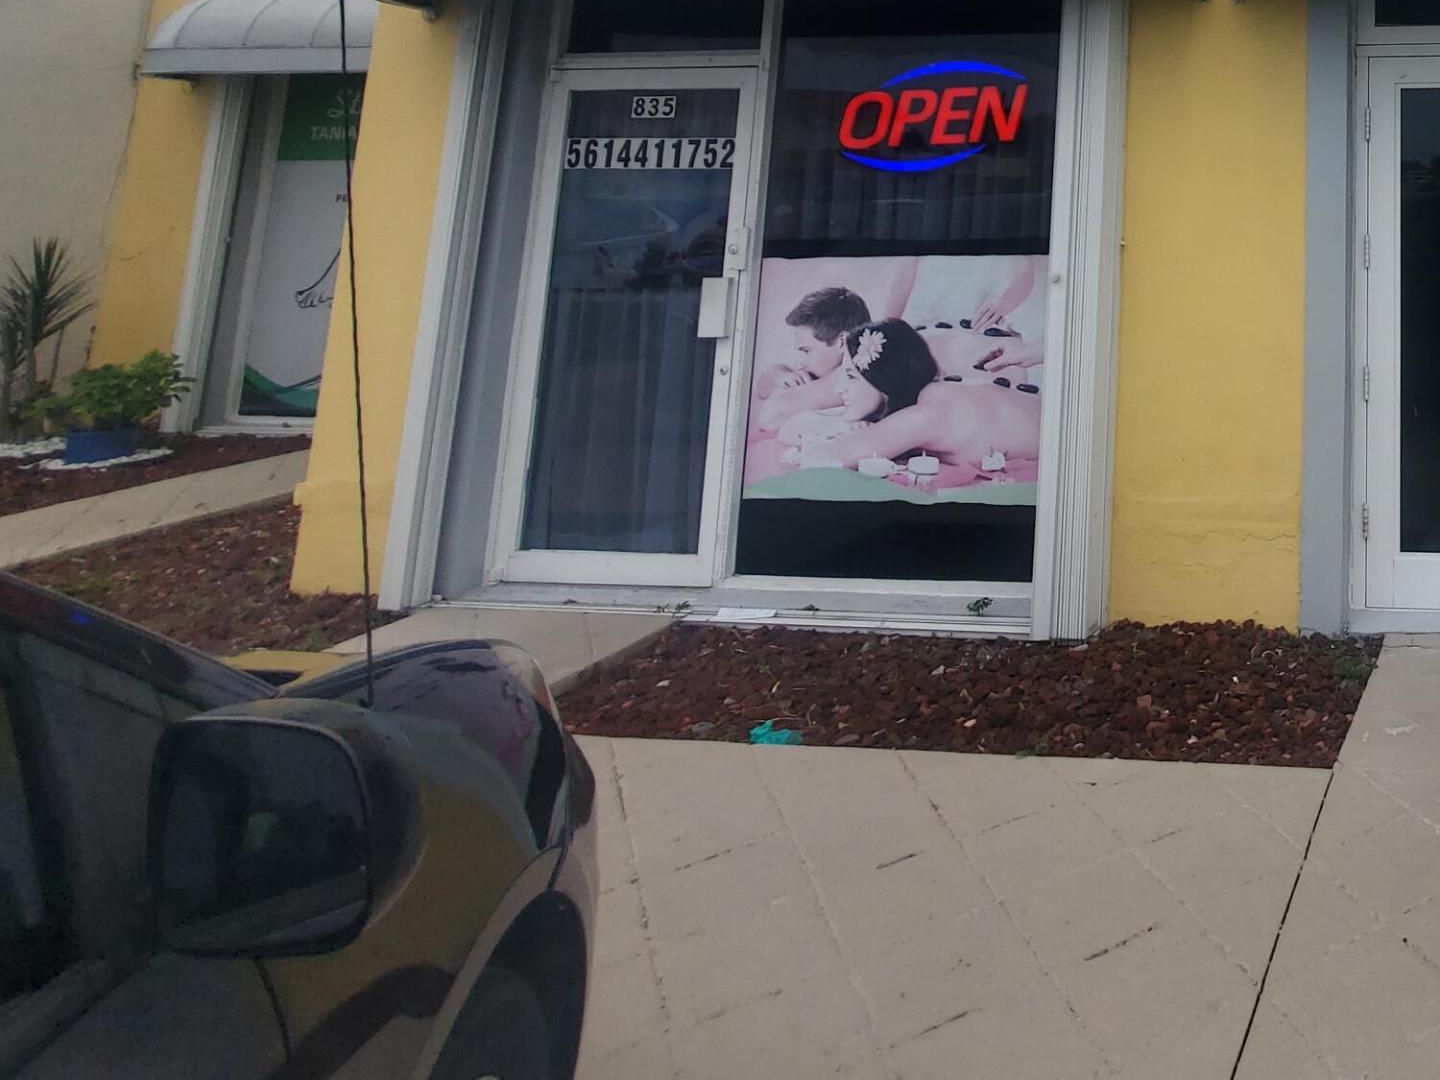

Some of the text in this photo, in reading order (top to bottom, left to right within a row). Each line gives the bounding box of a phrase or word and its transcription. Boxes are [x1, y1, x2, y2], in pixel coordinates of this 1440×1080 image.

[633, 97, 675, 118] 835
[838, 83, 1028, 150] OPEN
[566, 138, 737, 169] 5614411752
